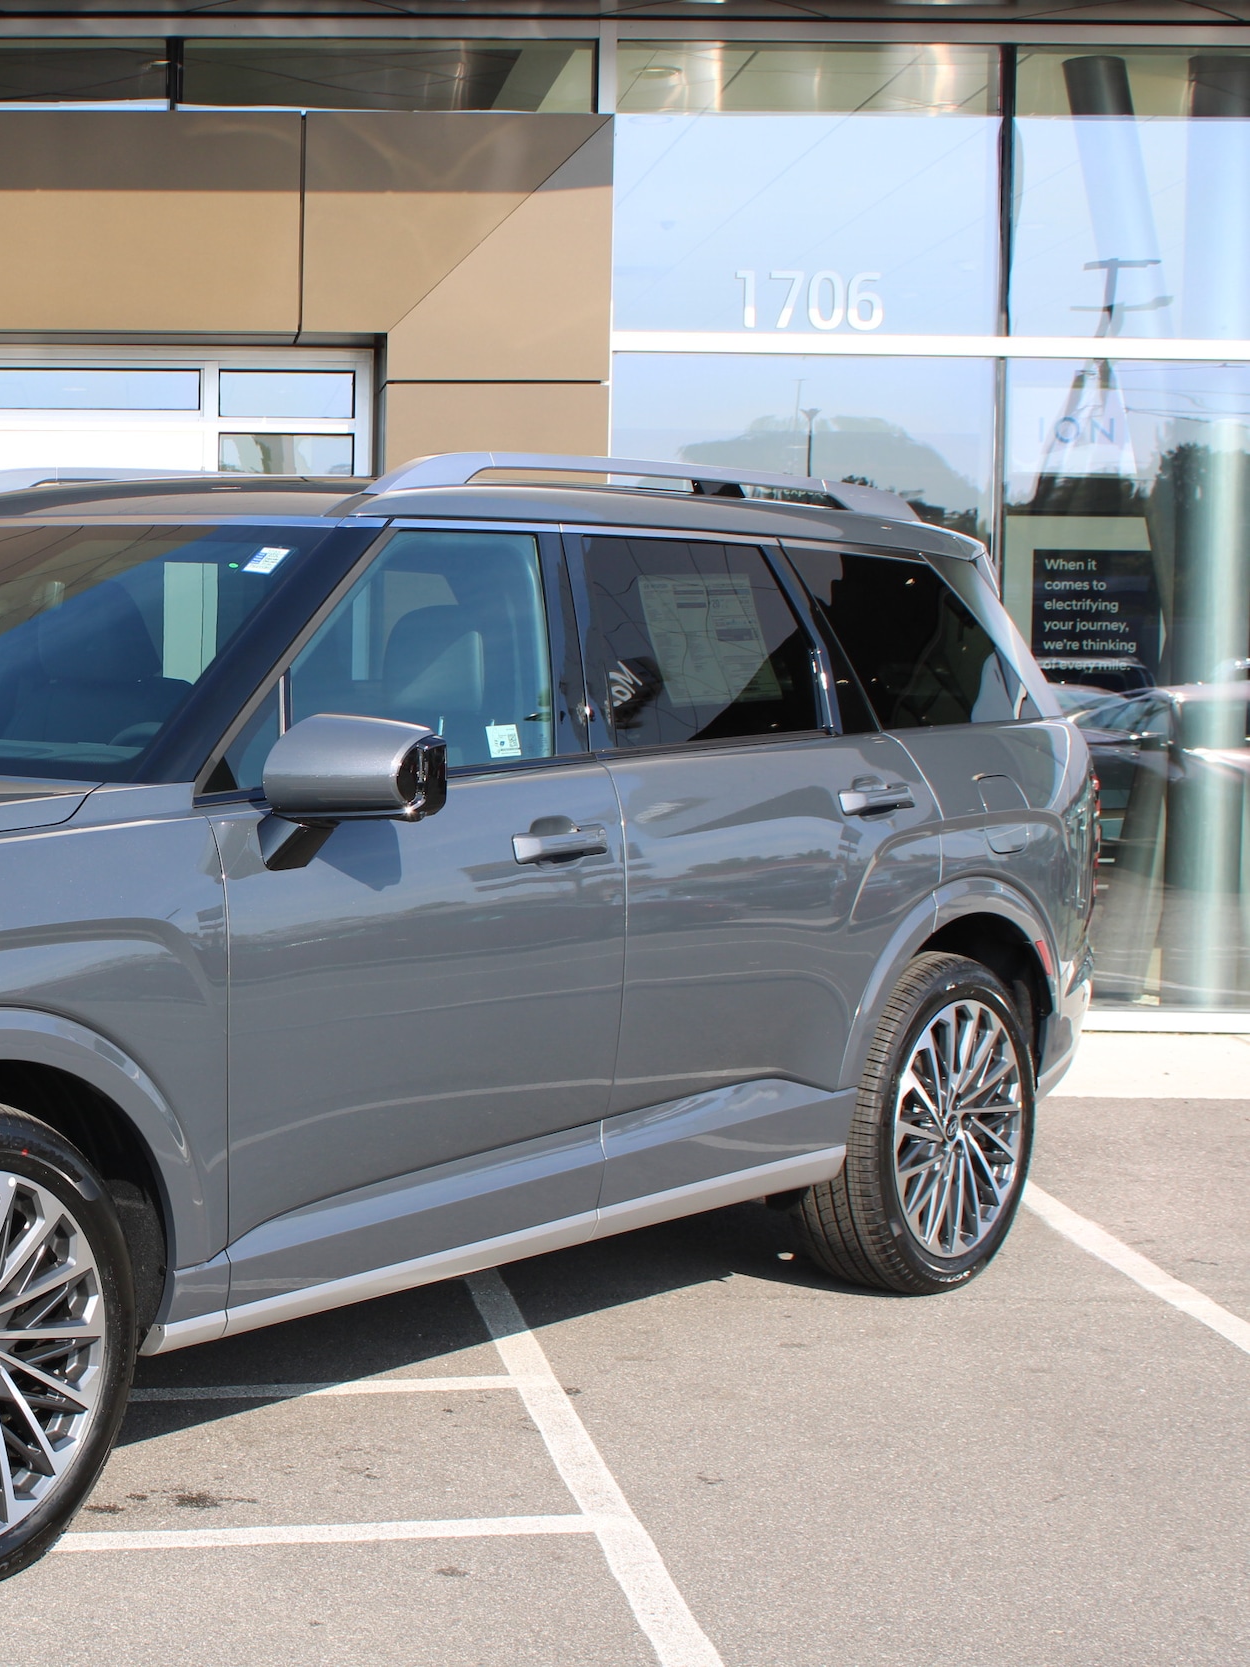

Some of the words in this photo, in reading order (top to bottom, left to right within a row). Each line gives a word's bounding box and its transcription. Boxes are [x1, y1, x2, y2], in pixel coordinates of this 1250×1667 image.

[735, 269, 884, 331] 1706
[1044, 558, 1085, 570] When
[1088, 558, 1097, 570] it
[1044, 581, 1090, 591] comes
[1093, 580, 1107, 591] to
[1043, 598, 1119, 613] electrifying
[1043, 620, 1074, 632] your
[1076, 618, 1130, 633] journey,
[1043, 639, 1080, 650] we're
[1082, 638, 1137, 653] thinking
[1042, 659, 1057, 670] of
[1060, 660, 1096, 673] every
